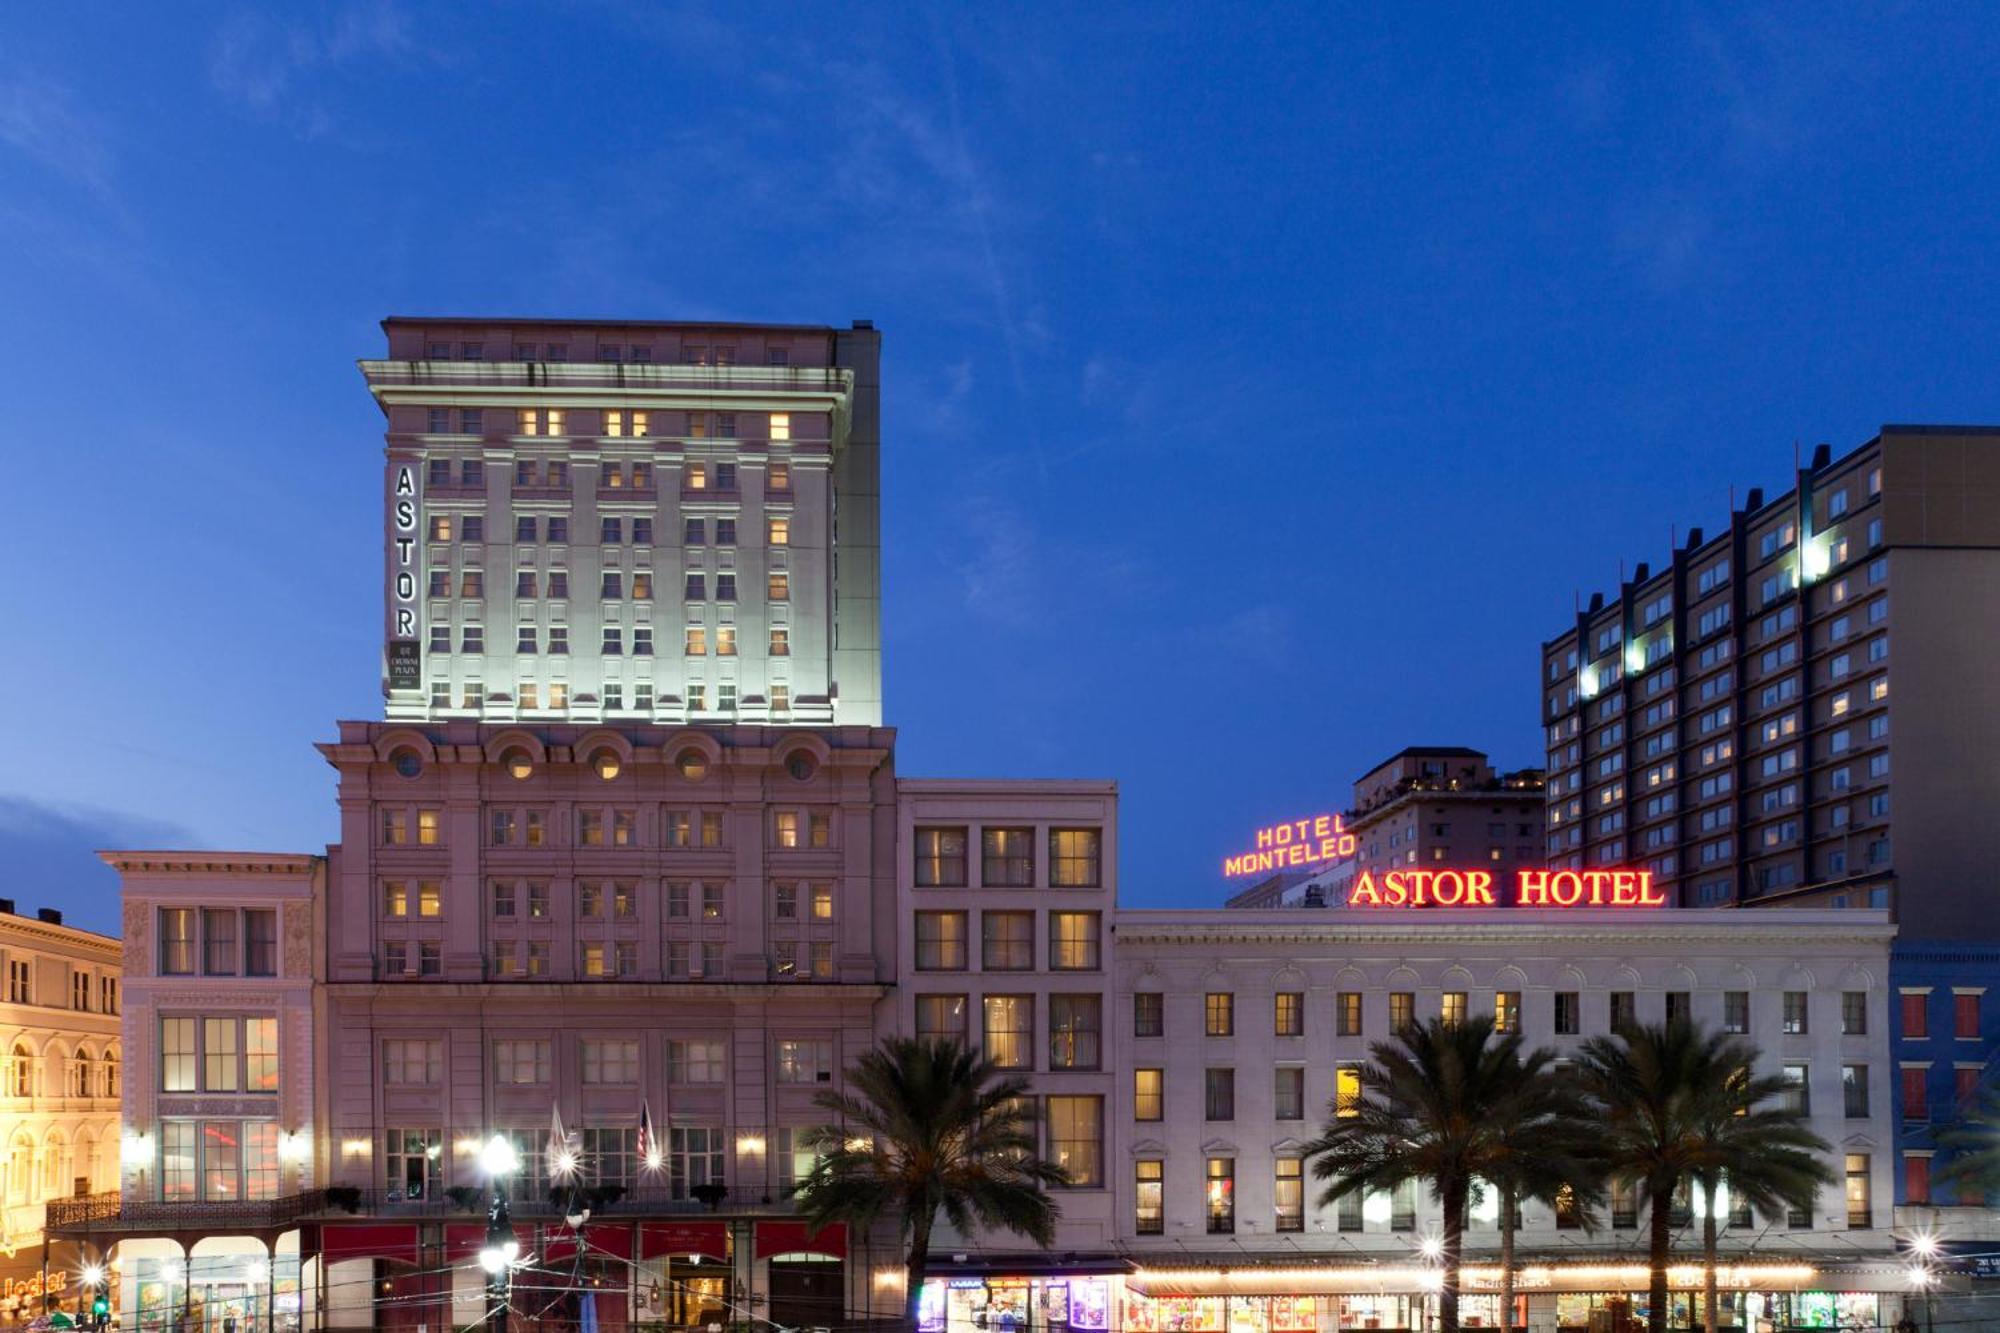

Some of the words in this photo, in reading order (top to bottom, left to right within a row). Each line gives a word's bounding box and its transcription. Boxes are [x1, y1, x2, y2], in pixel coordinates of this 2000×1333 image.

[396, 467, 415, 637] ASTOR
[1258, 814, 1345, 848] HOTEL
[1225, 834, 1356, 877] MONTELEO
[1349, 871, 1496, 905] ASTOR
[1517, 871, 1665, 905] HOTEL
[1672, 1275, 1751, 1288] cDoald's
